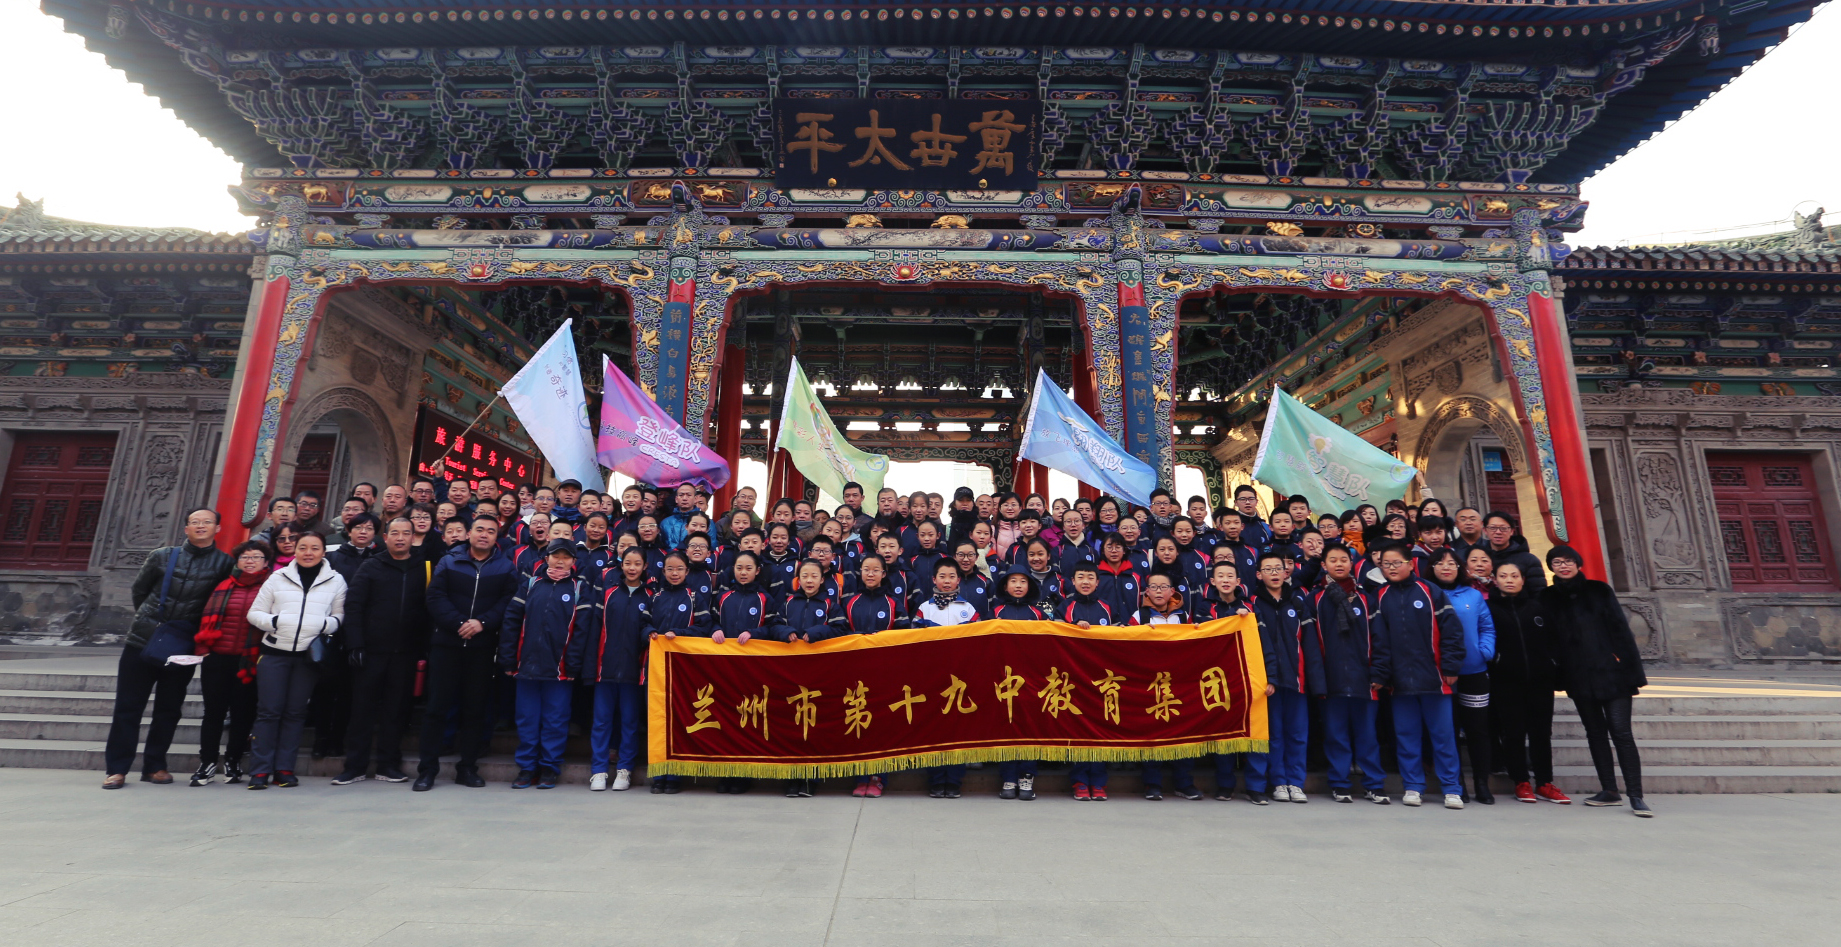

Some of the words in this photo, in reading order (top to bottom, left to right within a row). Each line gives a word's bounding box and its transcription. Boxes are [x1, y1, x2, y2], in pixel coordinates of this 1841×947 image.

[444, 456, 468, 472] Tourist
[636, 416, 701, 463] 登峰队
[1307, 450, 1370, 501] 智慧队
[686, 665, 1231, 741] 兰州市第十九中教育集团
